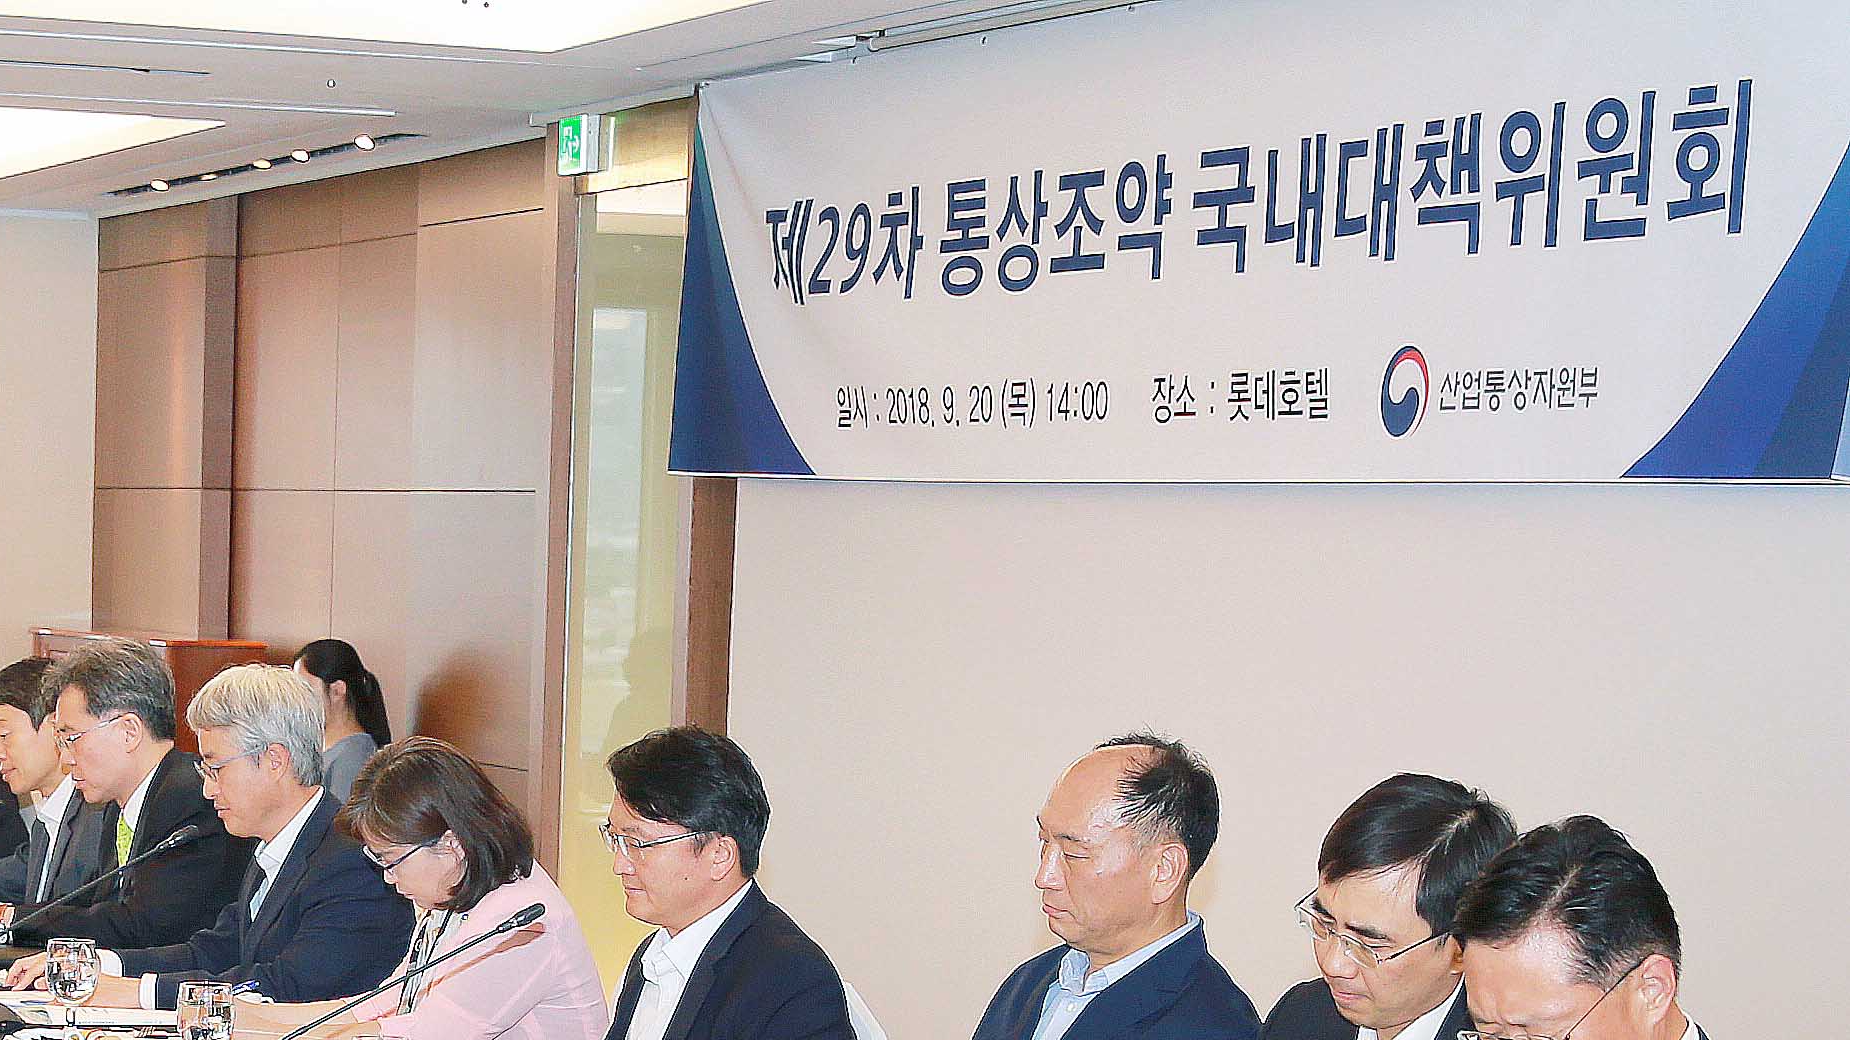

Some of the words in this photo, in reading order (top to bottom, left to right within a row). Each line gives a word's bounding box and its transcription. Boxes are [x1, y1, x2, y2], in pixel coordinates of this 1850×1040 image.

[766, 186, 924, 305] 제29차
[940, 154, 1172, 296] 통상조약
[1193, 79, 1753, 273] 국내대책위원회
[1047, 381, 1109, 422] 14:00
[1151, 373, 1197, 424] 장소
[1227, 367, 1329, 422] 롯데호텔
[1439, 366, 1599, 412] 산업통상자원부
